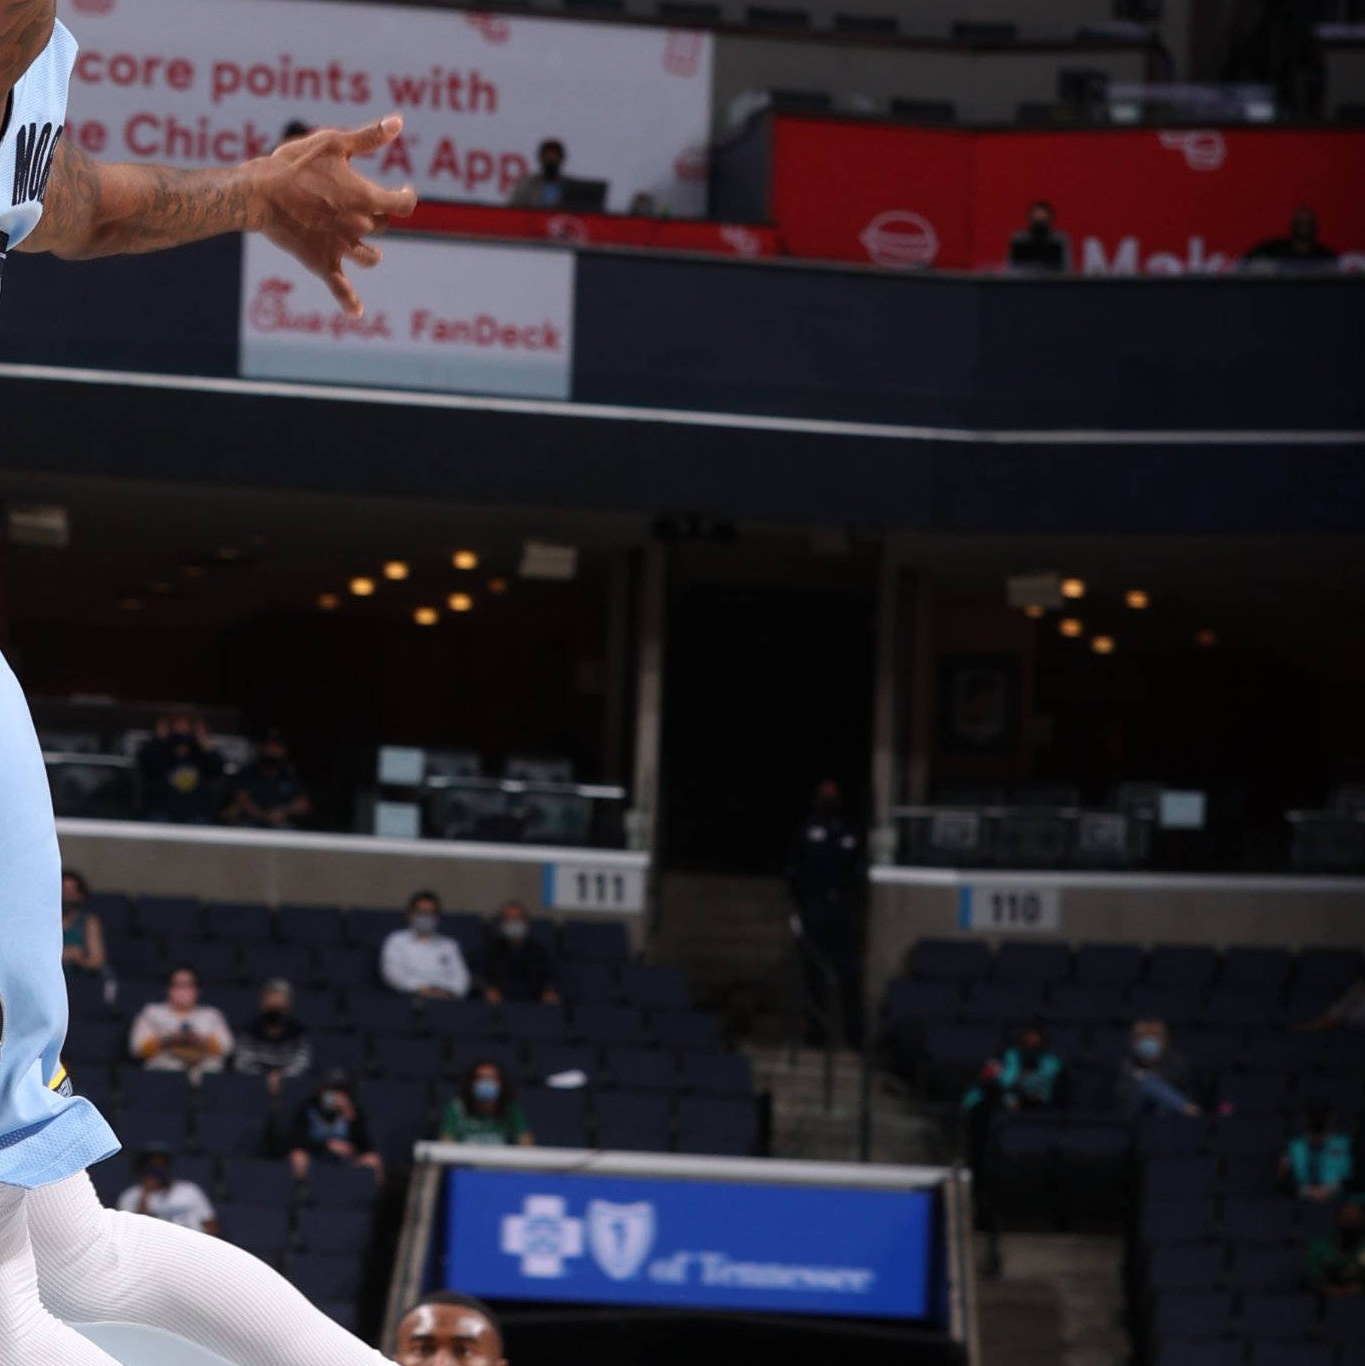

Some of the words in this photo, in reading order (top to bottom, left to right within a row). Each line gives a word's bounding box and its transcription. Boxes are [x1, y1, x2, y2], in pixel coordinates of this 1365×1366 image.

[76, 51, 194, 91] core
[211, 55, 370, 104] points
[388, 64, 497, 113] with
[429, 136, 528, 192] App
[410, 309, 562, 351] FanDeck
[577, 871, 624, 902] 111
[991, 893, 1041, 924] 110
